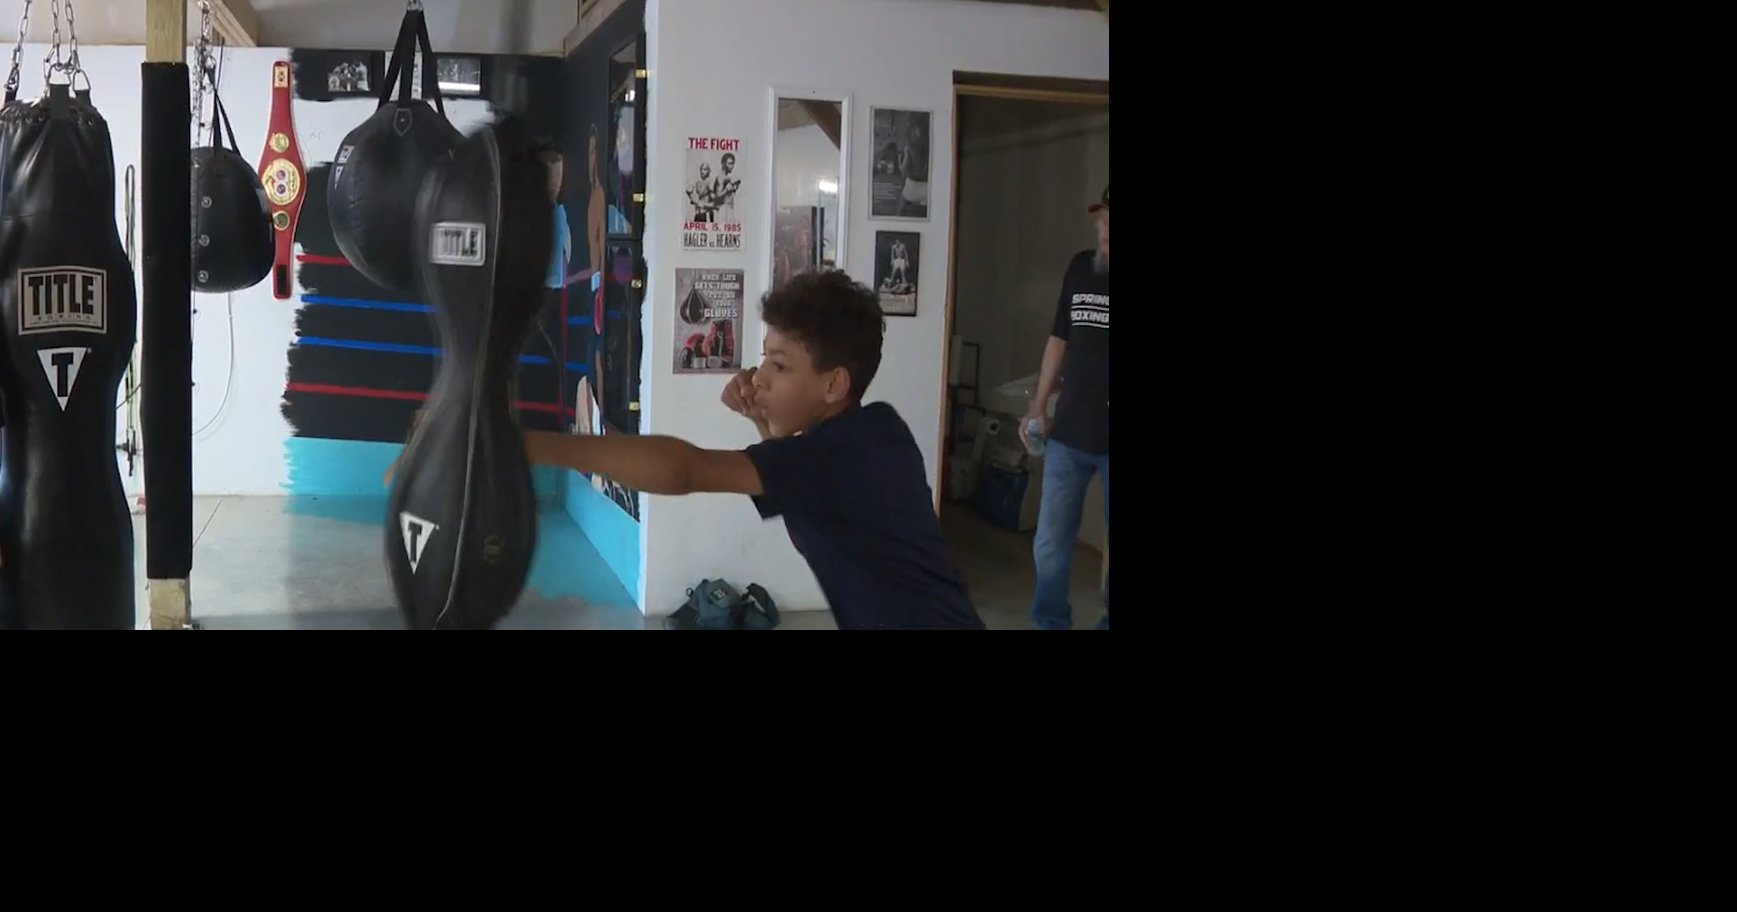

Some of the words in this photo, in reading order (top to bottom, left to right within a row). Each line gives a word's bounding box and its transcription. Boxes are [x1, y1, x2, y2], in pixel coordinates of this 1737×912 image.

[688, 137, 708, 150] THE
[710, 138, 740, 151] FIGHT
[683, 222, 707, 231] APRIL
[724, 223, 742, 232] 1985
[683, 232, 708, 248] HAGLER
[716, 233, 742, 249] HEARNS
[694, 281, 714, 290] GETS
[716, 282, 740, 291] TOUGH
[28, 273, 95, 316] TITLE
[703, 307, 739, 319] GLOVES
[51, 352, 74, 398] T
[408, 521, 423, 563] T
